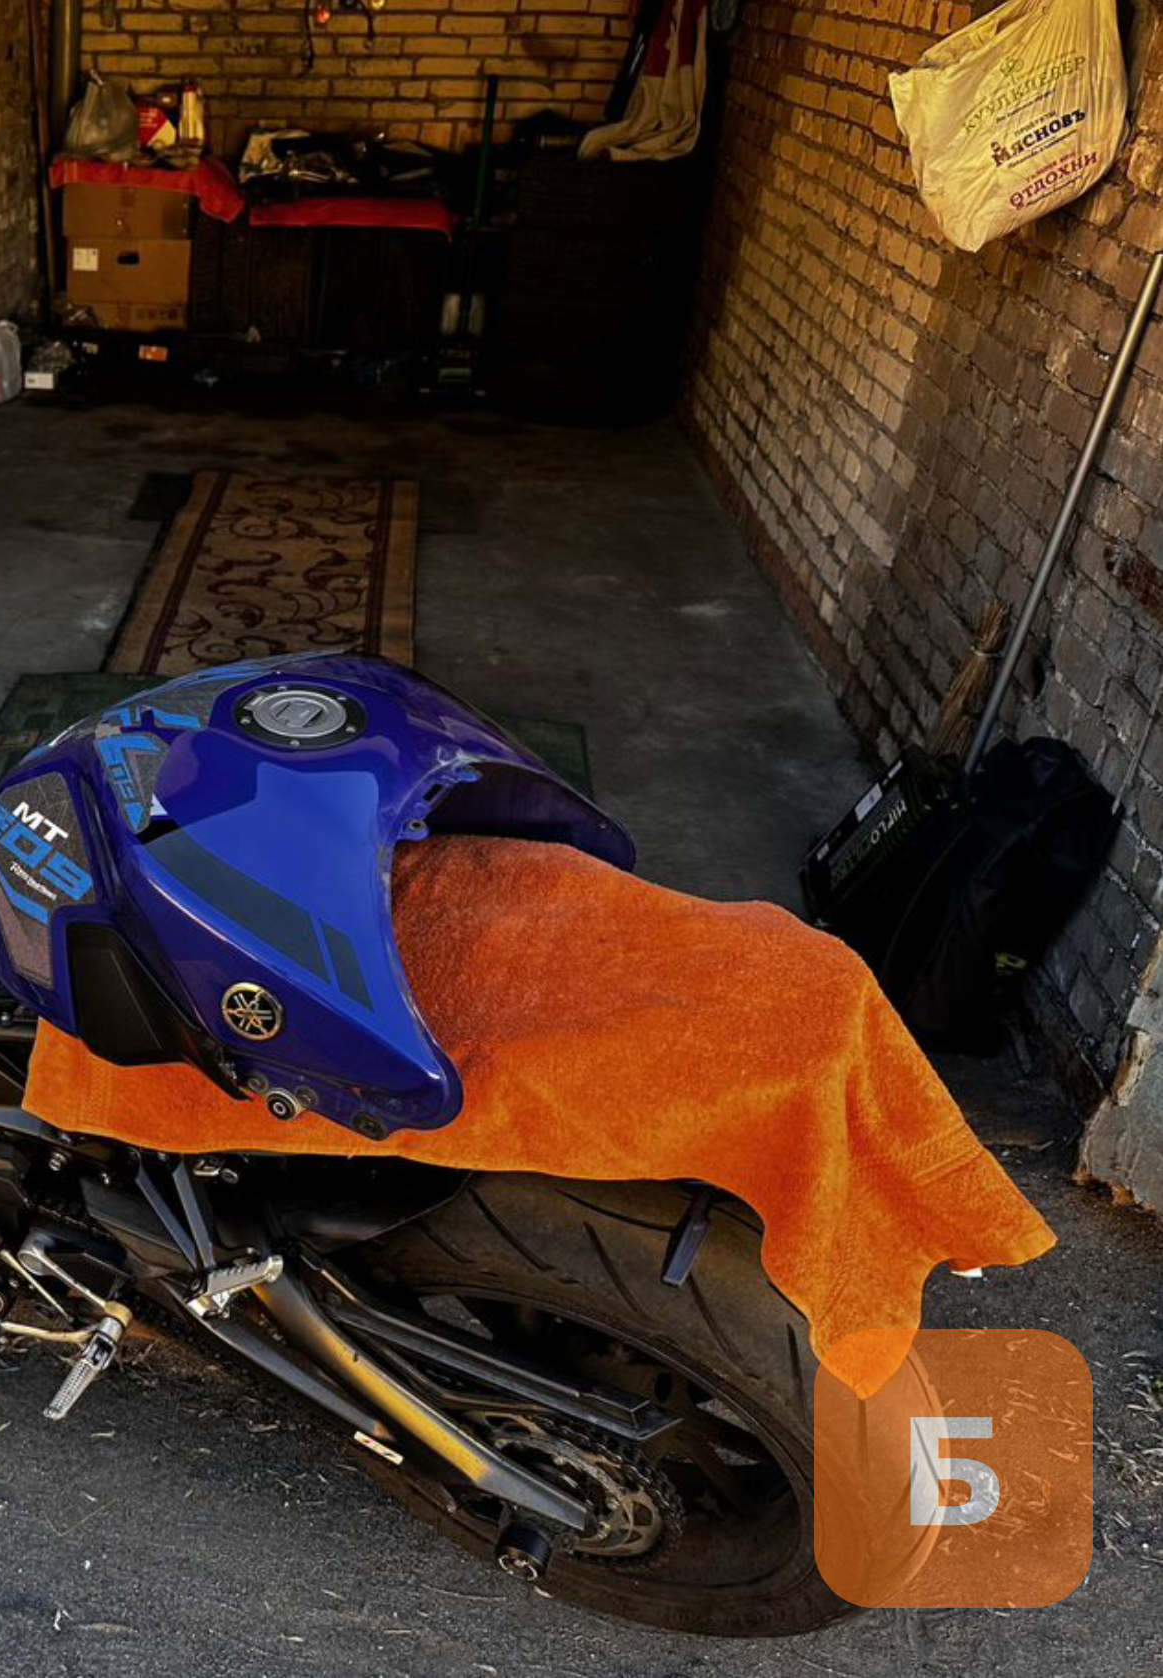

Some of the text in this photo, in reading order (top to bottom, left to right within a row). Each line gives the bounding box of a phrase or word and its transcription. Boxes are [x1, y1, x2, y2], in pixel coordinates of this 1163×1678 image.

[991, 109, 1086, 167] МЯСНОВЪ
[1009, 152, 1097, 209] ОТДОХНИ
[12, 801, 69, 843] MT
